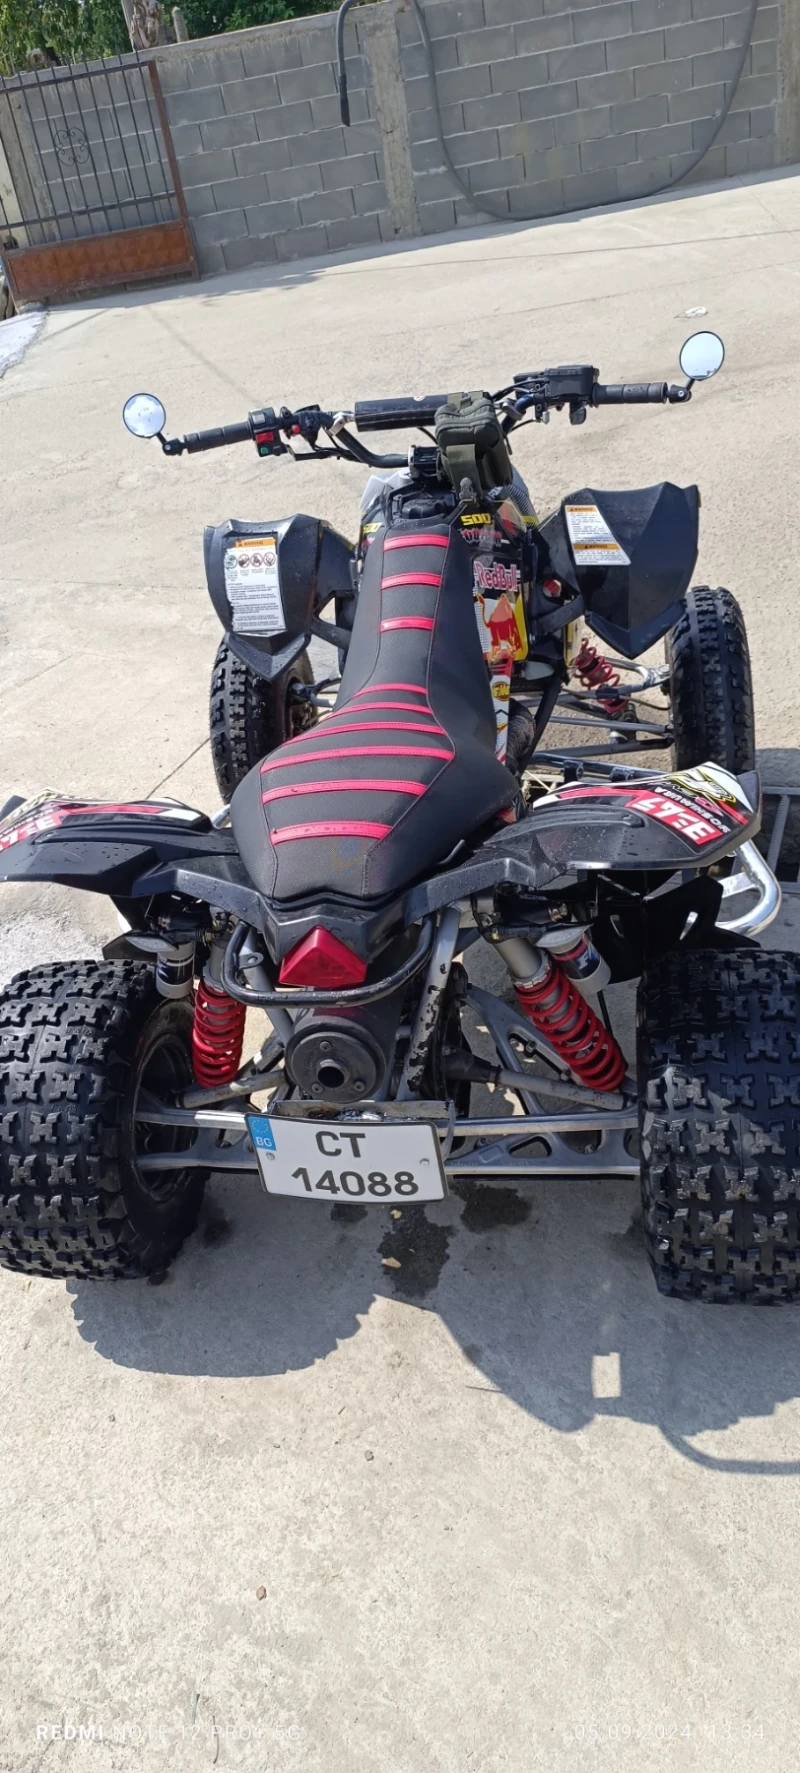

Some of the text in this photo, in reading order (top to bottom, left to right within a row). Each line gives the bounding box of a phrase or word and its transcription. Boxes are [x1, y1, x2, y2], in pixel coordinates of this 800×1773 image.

[461, 513, 491, 526] 500
[654, 786, 731, 834] YOSHIMURA
[255, 1136, 273, 1148] BG
[315, 1131, 366, 1158] CT
[291, 1167, 419, 1197] 14088
